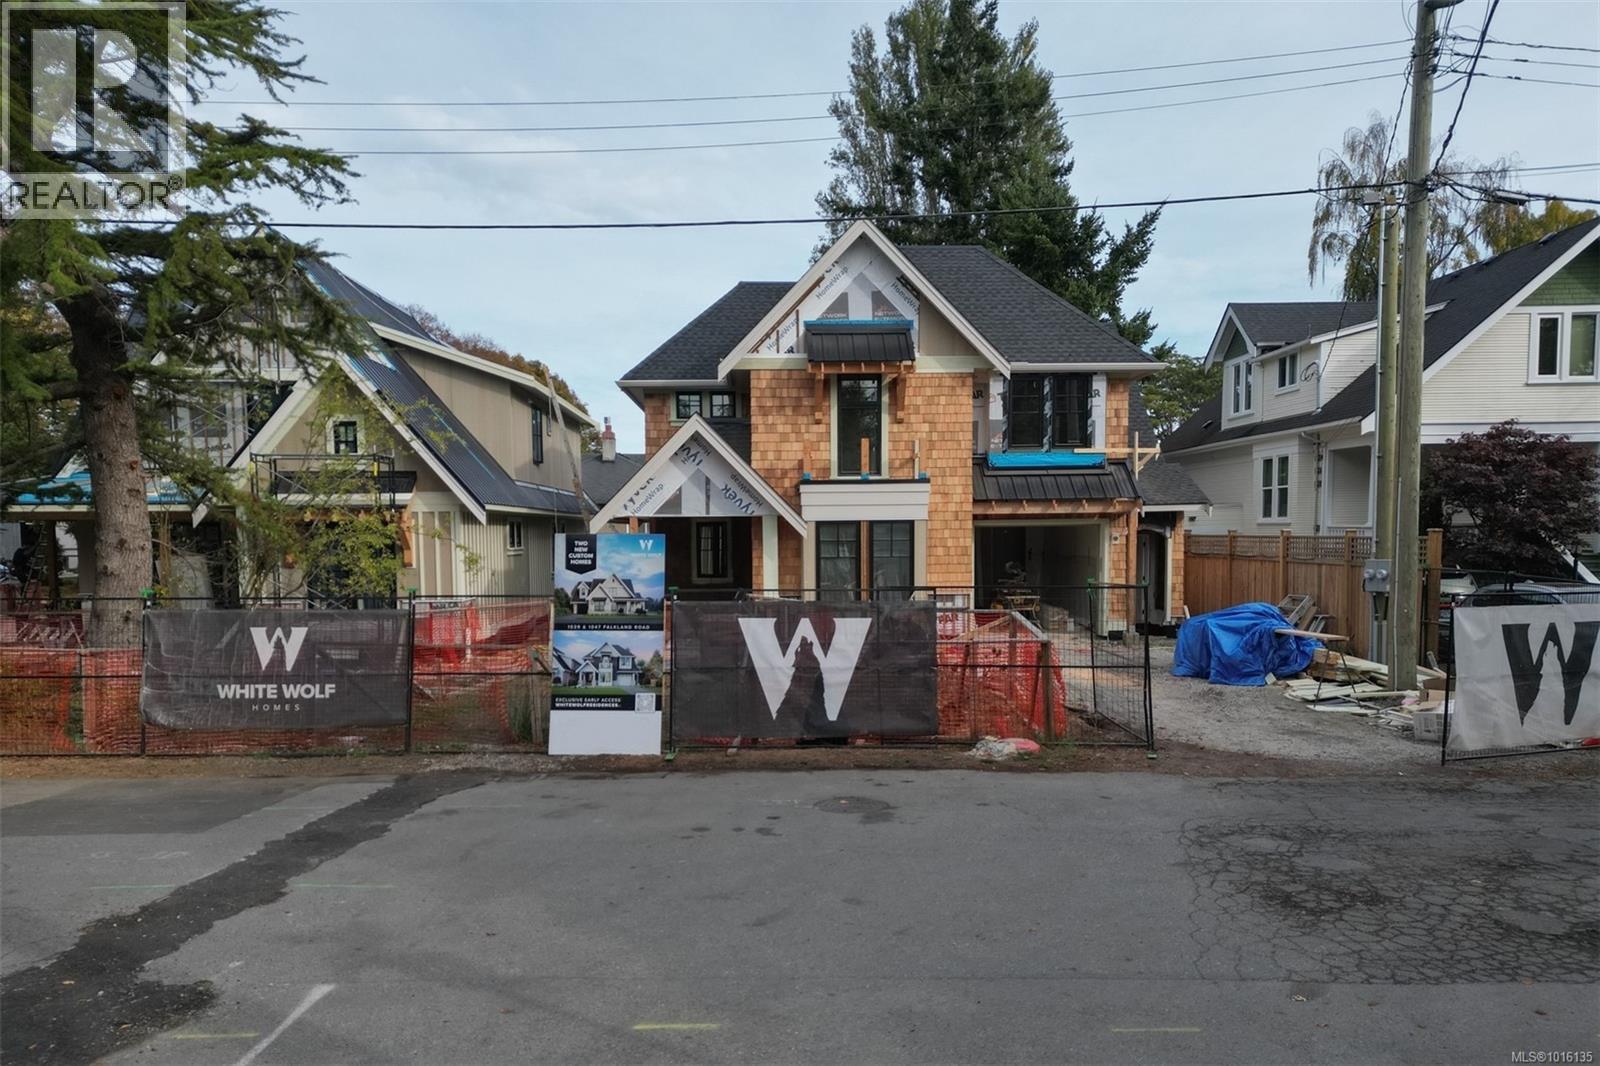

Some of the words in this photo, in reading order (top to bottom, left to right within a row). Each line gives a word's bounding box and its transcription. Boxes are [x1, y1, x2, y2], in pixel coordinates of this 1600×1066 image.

[815, 267, 849, 299] HomeWrap
[890, 281, 919, 314] HomeWra
[767, 318, 798, 351] HoeWra
[631, 483, 664, 514] HomeWrap
[730, 473, 762, 507] HomeWrap
[250, 627, 308, 672] W
[737, 617, 872, 721] W
[1501, 621, 1600, 727] W
[217, 684, 278, 699] WHITE
[282, 684, 336, 698] WOLF
